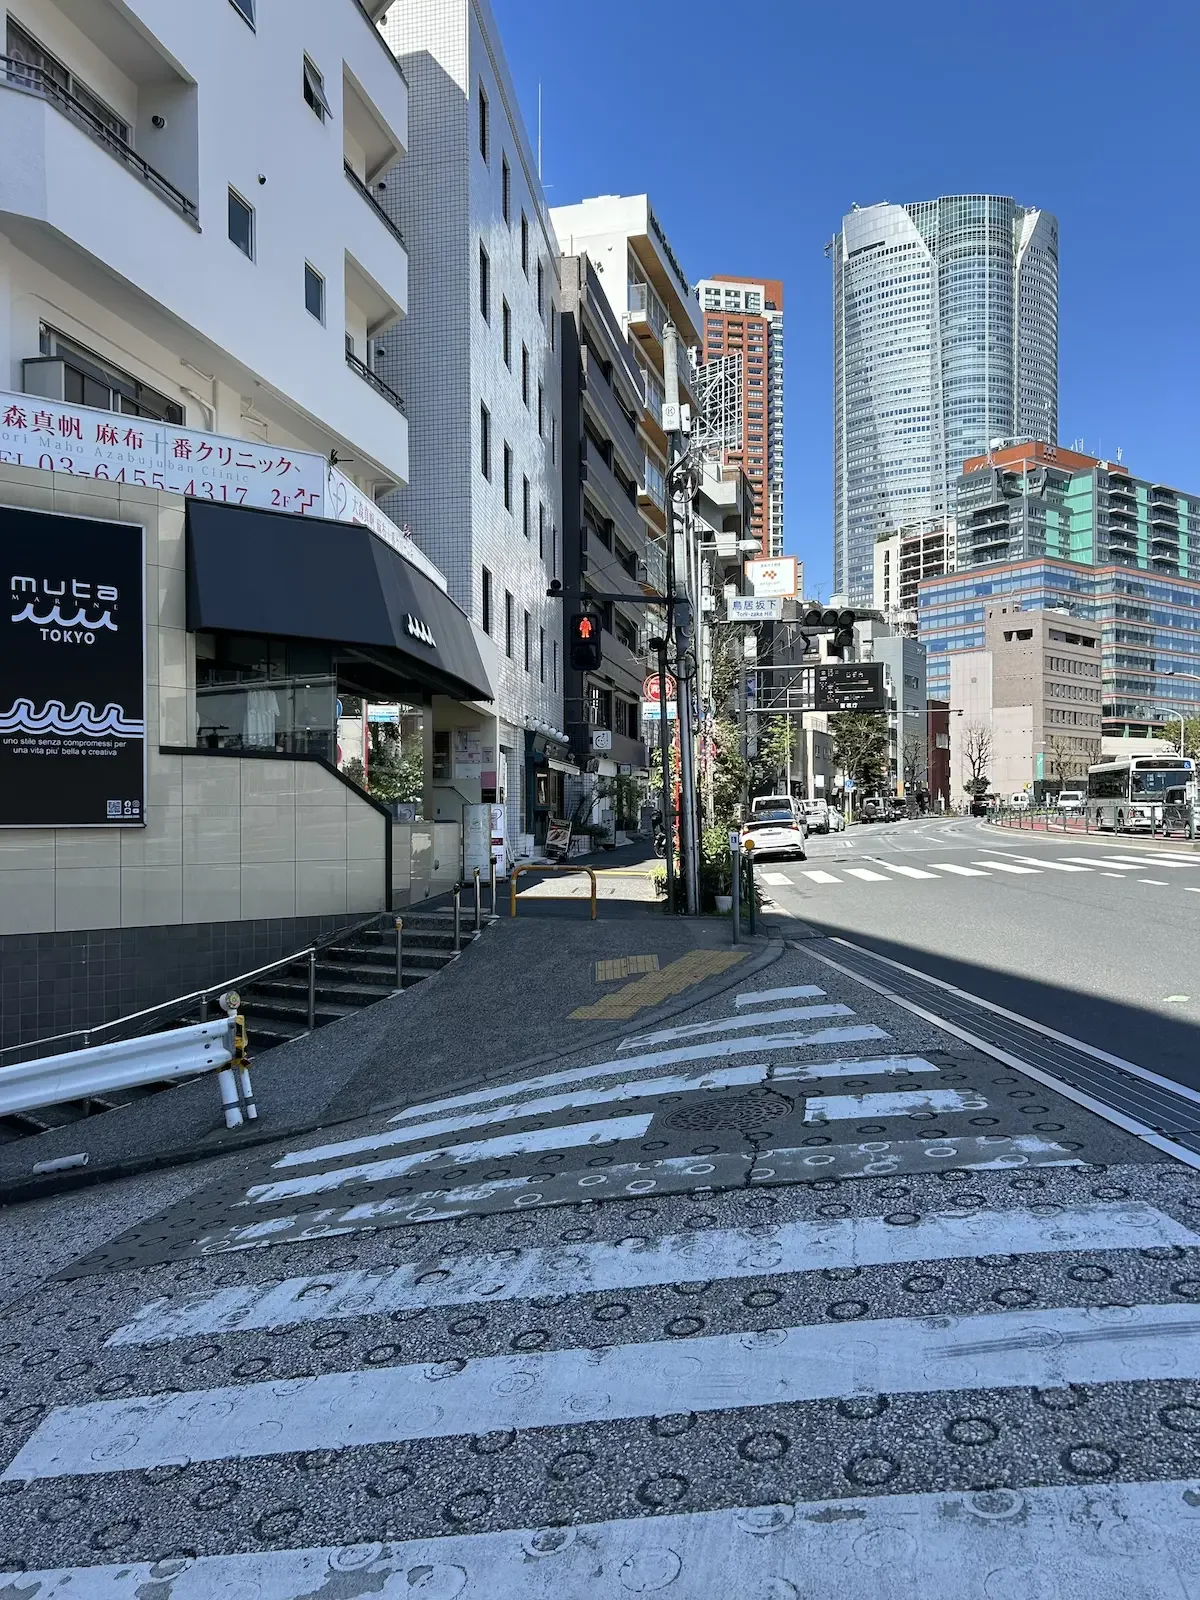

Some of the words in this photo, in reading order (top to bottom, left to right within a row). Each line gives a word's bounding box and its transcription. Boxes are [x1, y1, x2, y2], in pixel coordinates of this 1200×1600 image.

[39, 436, 84, 454] Maho
[94, 447, 194, 473] Azabujuban
[202, 465, 249, 483] Clinic
[271, 488, 291, 508] 2F
[11, 576, 118, 601] muta
[11, 594, 119, 610] MARINE
[732, 600, 777, 610] 鳥居坂下
[40, 628, 96, 645] TOKYO
[20, 738, 37, 746] stile
[63, 740, 113, 748] compromessi
[62, 748, 80, 756] bella
[88, 748, 117, 757] creativa
